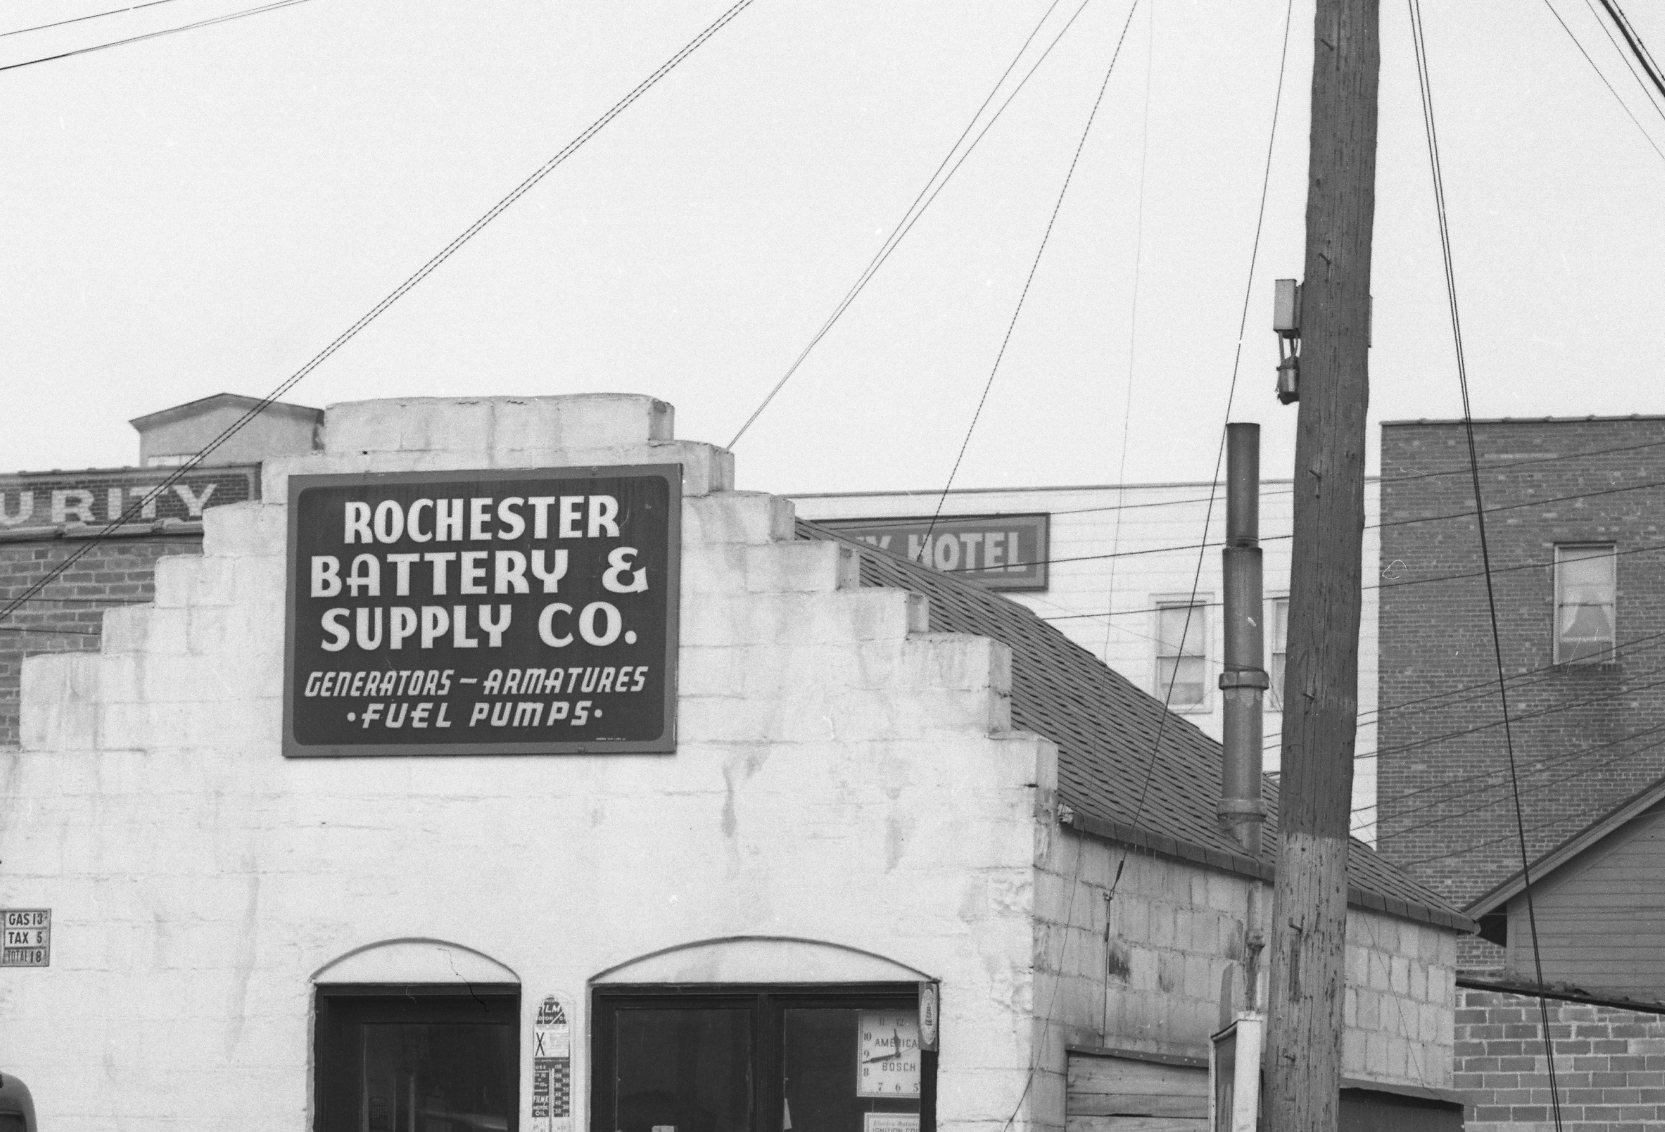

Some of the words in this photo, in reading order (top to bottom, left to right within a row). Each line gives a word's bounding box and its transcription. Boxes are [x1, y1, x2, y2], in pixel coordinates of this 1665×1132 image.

[344, 494, 621, 545] ROCHESTER
[907, 531, 1027, 574] HOTEL
[310, 548, 569, 598] BATTERY
[601, 546, 649, 594] &
[320, 604, 513, 652] SUPPLY
[538, 601, 637, 648] CO.
[304, 670, 455, 698] GENERATORS
[483, 666, 649, 696] ARMATURES
[8, 913, 30, 926] GAS
[8, 931, 29, 944] TAX
[36, 931, 43, 944] 5
[863, 1031, 872, 1041] 10
[882, 1062, 916, 1072] BOSCH
[877, 1082, 884, 1092] 7
[895, 1082, 901, 1092] 6
